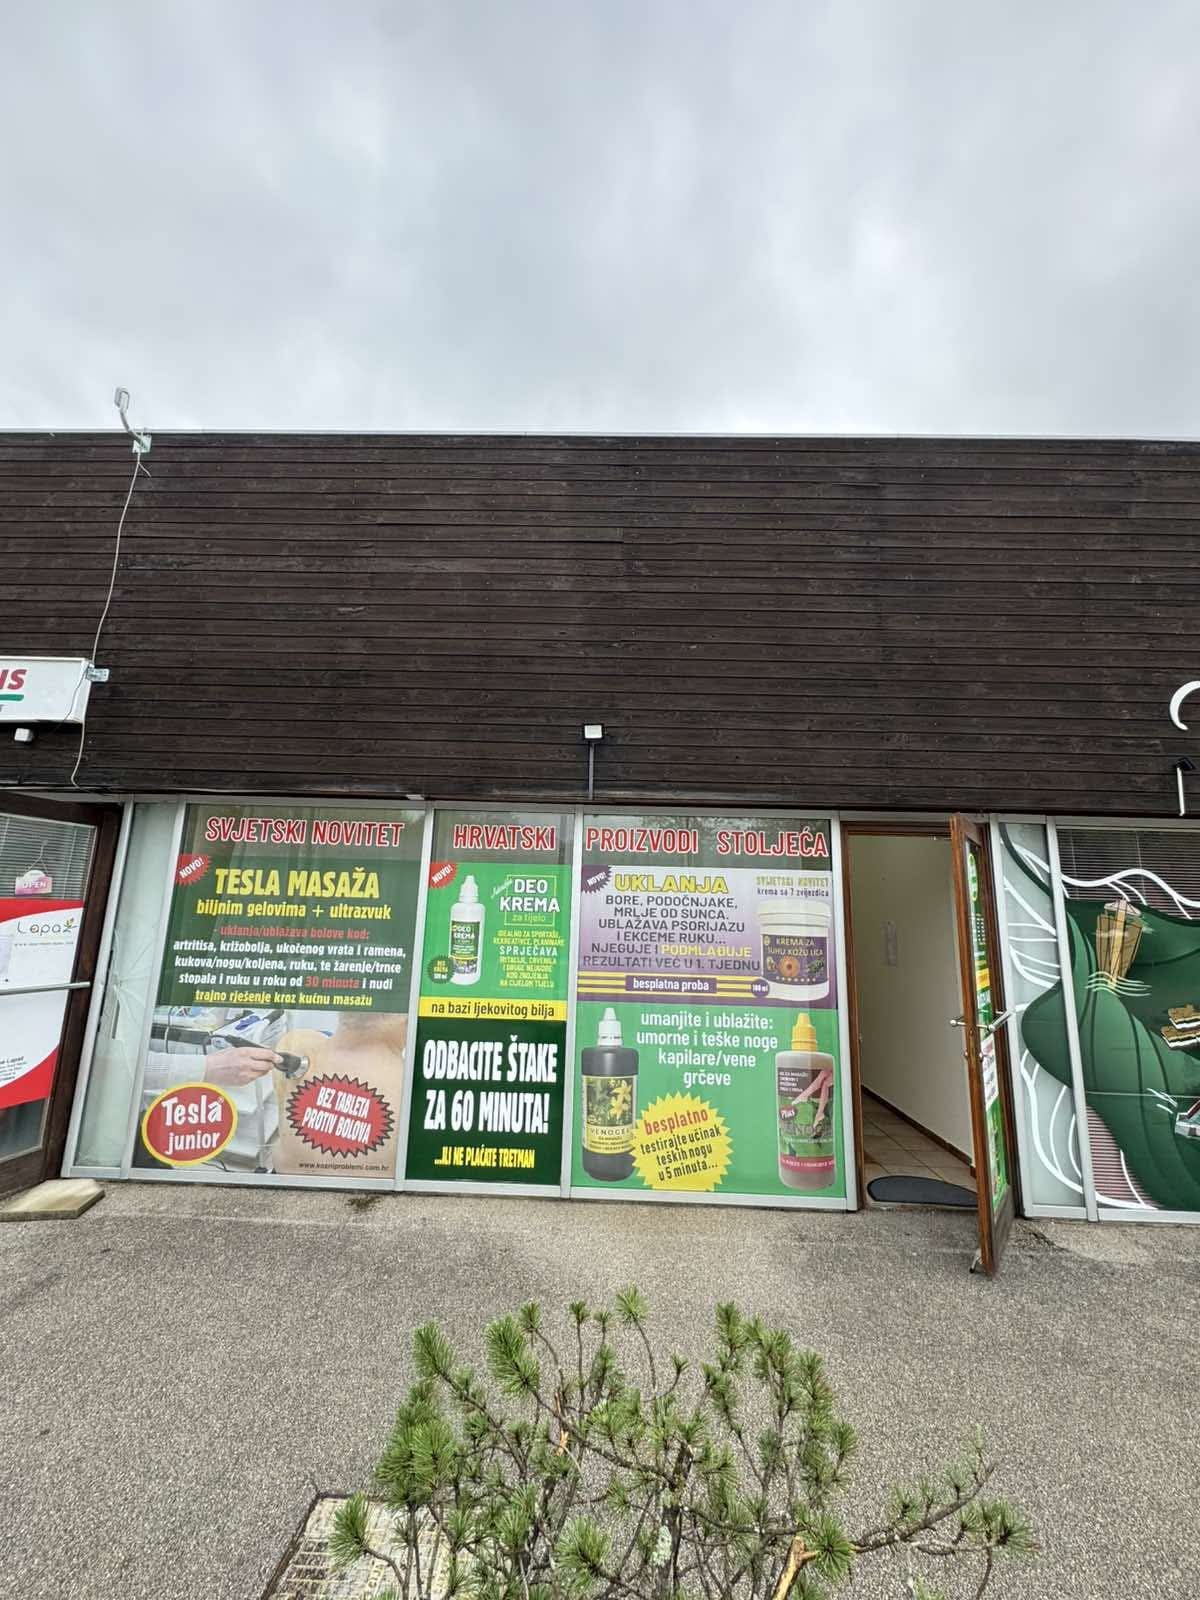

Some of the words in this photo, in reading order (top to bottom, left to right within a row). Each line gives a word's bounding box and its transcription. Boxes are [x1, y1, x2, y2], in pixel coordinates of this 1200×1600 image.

[205, 816, 307, 844] SVJETSKI
[311, 820, 405, 847] NOVITET
[453, 824, 556, 850] HRVATSKI
[585, 827, 699, 854] PROIZVODI
[716, 826, 829, 857] STOLJEĆA
[179, 857, 204, 879] NOVO!
[432, 864, 452, 884] NOVO!
[215, 868, 280, 896] TESLA
[287, 867, 380, 899] MASAŽA
[514, 879, 548, 893] DEO
[586, 871, 607, 886] NOVO!
[614, 873, 729, 894] UKLANJA
[196, 899, 243, 916] biljnim
[247, 902, 306, 917] gelovima
[329, 903, 392, 920] ultrazvuk
[500, 896, 560, 912] KREMA
[605, 895, 643, 907] BORE,
[646, 893, 738, 909] PODOČNJAKE,
[614, 908, 657, 918] MRLJE
[660, 908, 678, 919] OD
[681, 909, 729, 920] SUNCA.
[598, 917, 668, 930] UBLAŽAVA
[671, 920, 745, 932] PSORIJAZU
[616, 932, 620, 942] I
[623, 932, 675, 943] EKCEME
[679, 933, 726, 944] RUKU...
[173, 940, 217, 952] artritisa,
[220, 941, 273, 954] križobolja,
[276, 943, 325, 956] ukočenog
[327, 945, 354, 956] vrata
[363, 947, 406, 959] ramena,
[499, 945, 557, 956] SPRJEČAVA
[591, 943, 652, 954] NJEGUJE
[174, 955, 287, 970] kukova/nogu/koljena,
[290, 960, 317, 972] ruku,
[320, 961, 331, 971] te
[334, 960, 402, 973] žarenje/trnce
[583, 956, 652, 968] REZULTATI
[684, 958, 693, 969] U
[710, 959, 760, 971] TJEDNU
[178, 973, 216, 985] stopala
[225, 974, 250, 985] ruku
[252, 977, 260, 985] u
[263, 975, 287, 986] roku
[289, 976, 303, 987] od
[305, 976, 319, 988] 30
[369, 978, 393, 990] nudi
[633, 977, 679, 991] besplatna
[681, 980, 709, 992] proba
[195, 990, 226, 1001] trajno
[229, 991, 271, 1003] rješenje
[274, 992, 296, 1003] kroz
[299, 993, 330, 1004] kućnu
[333, 994, 372, 1005] masažu
[431, 1003, 445, 1013] na
[448, 1002, 471, 1014] bazi
[474, 1002, 528, 1018] ljekovitog
[531, 1004, 555, 1019] bilja
[641, 1011, 702, 1030] umanjite
[705, 1012, 710, 1027] i
[714, 1012, 773, 1030] ublažite:
[636, 1031, 690, 1046] umorne
[694, 1031, 698, 1046] i
[702, 1031, 740, 1047] teške
[744, 1037, 778, 1052] noge
[422, 1040, 503, 1081] ODBACITE
[507, 1034, 558, 1083] ŠTAKE
[658, 1048, 756, 1068] kapilare/vene
[683, 1069, 732, 1089] grčeve
[316, 1087, 336, 1109] BEZ
[335, 1091, 371, 1119] TABLETA
[424, 1090, 446, 1130] ZA
[451, 1090, 475, 1132] 60
[478, 1091, 550, 1134] MINUTA!
[301, 1107, 338, 1134] PROTIV
[335, 1115, 372, 1144] BOLOVA
[644, 1109, 709, 1136] besplatno
[165, 1130, 220, 1155] junior
[640, 1134, 688, 1155] testirajte
[689, 1124, 722, 1142] učinak
[453, 1147, 464, 1166] NE
[499, 1148, 535, 1168] TRETMAN
[656, 1148, 688, 1166] teških
[689, 1143, 713, 1159] nogu
[658, 1171, 665, 1181] u
[666, 1167, 673, 1179] 5
[673, 1160, 718, 1177] minuta...
